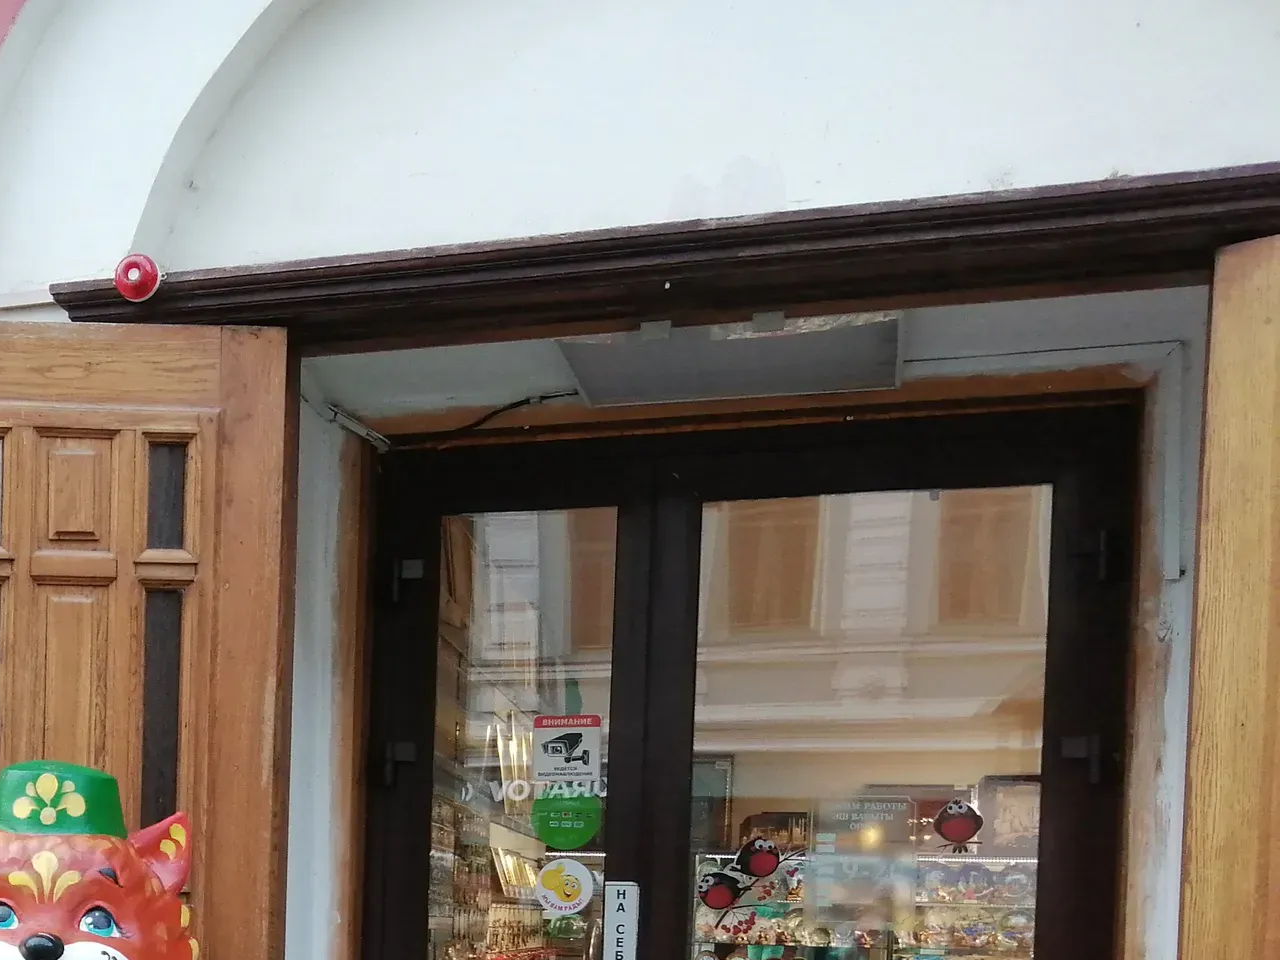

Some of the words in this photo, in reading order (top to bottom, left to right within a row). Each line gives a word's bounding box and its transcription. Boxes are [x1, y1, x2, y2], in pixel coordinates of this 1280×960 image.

[542, 718, 593, 726] ВНИМАНИЕ
[864, 802, 907, 811] РАБОТЫ
[615, 889, 626, 913] НА
